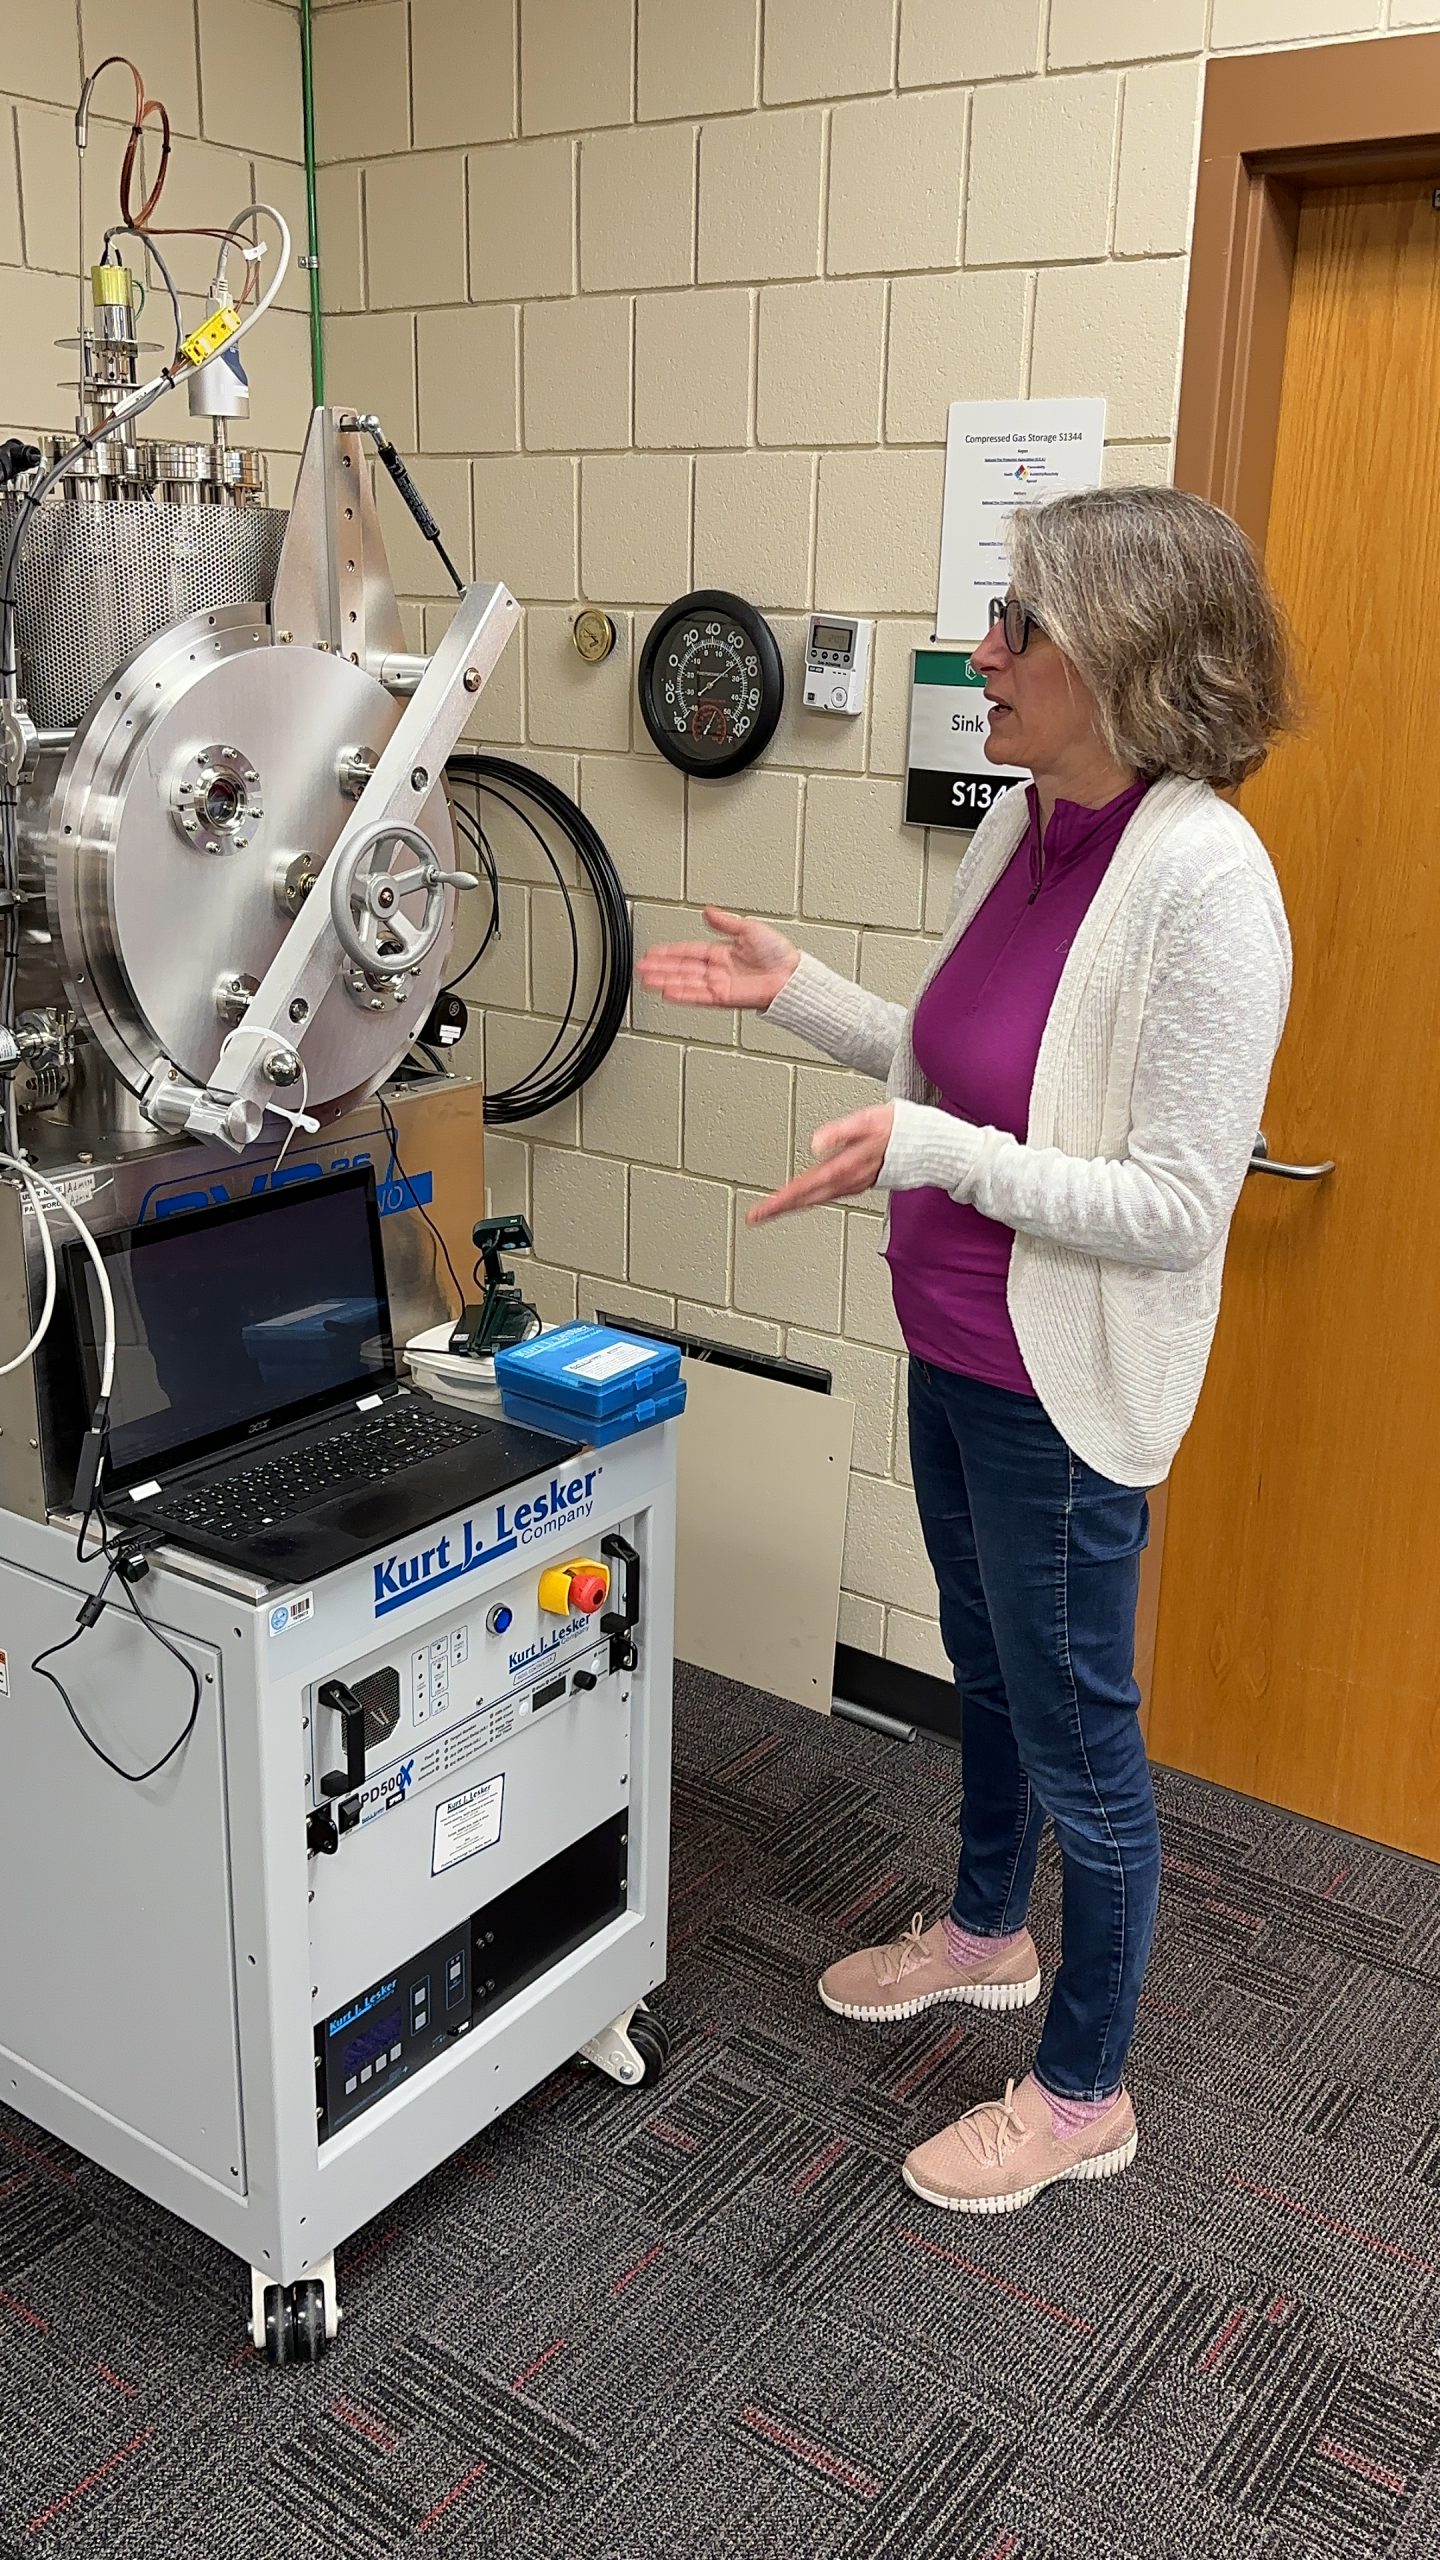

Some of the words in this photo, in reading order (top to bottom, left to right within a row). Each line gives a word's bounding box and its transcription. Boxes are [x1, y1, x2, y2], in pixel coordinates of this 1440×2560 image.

[965, 433, 1011, 445] Compressed
[1012, 433, 1027, 443] Gas
[1027, 432, 1057, 444] Storage
[1058, 432, 1083, 442] S1344
[683, 629, 699, 647] 20
[705, 622, 721, 636] 40
[727, 631, 744, 649] 60
[668, 654, 679, 667] 0
[703, 649, 709, 657] 0
[715, 650, 723, 658] 10
[725, 660, 734, 668] 20
[745, 655, 758, 677] 80
[731, 675, 740, 683] 30
[665, 679, 675, 704] -20
[746, 687, 760, 711] 100
[673, 711, 687, 733] -40
[732, 715, 750, 738] 120
[951, 714, 985, 733] Sink
[24, 1201, 61, 1213] PAWORD
[248, 1418, 270, 1434] acer
[520, 1500, 594, 1545] Company
[373, 1535, 451, 1602] Kurt
[461, 1519, 484, 1571] J.
[495, 1470, 597, 1542] Lesker
[508, 1643, 536, 1669] Kurt
[539, 1636, 548, 1653] J.
[551, 1614, 591, 1643] Lesker
[329, 2011, 351, 2032] Kurt
[364, 1978, 398, 2008] Lesker
